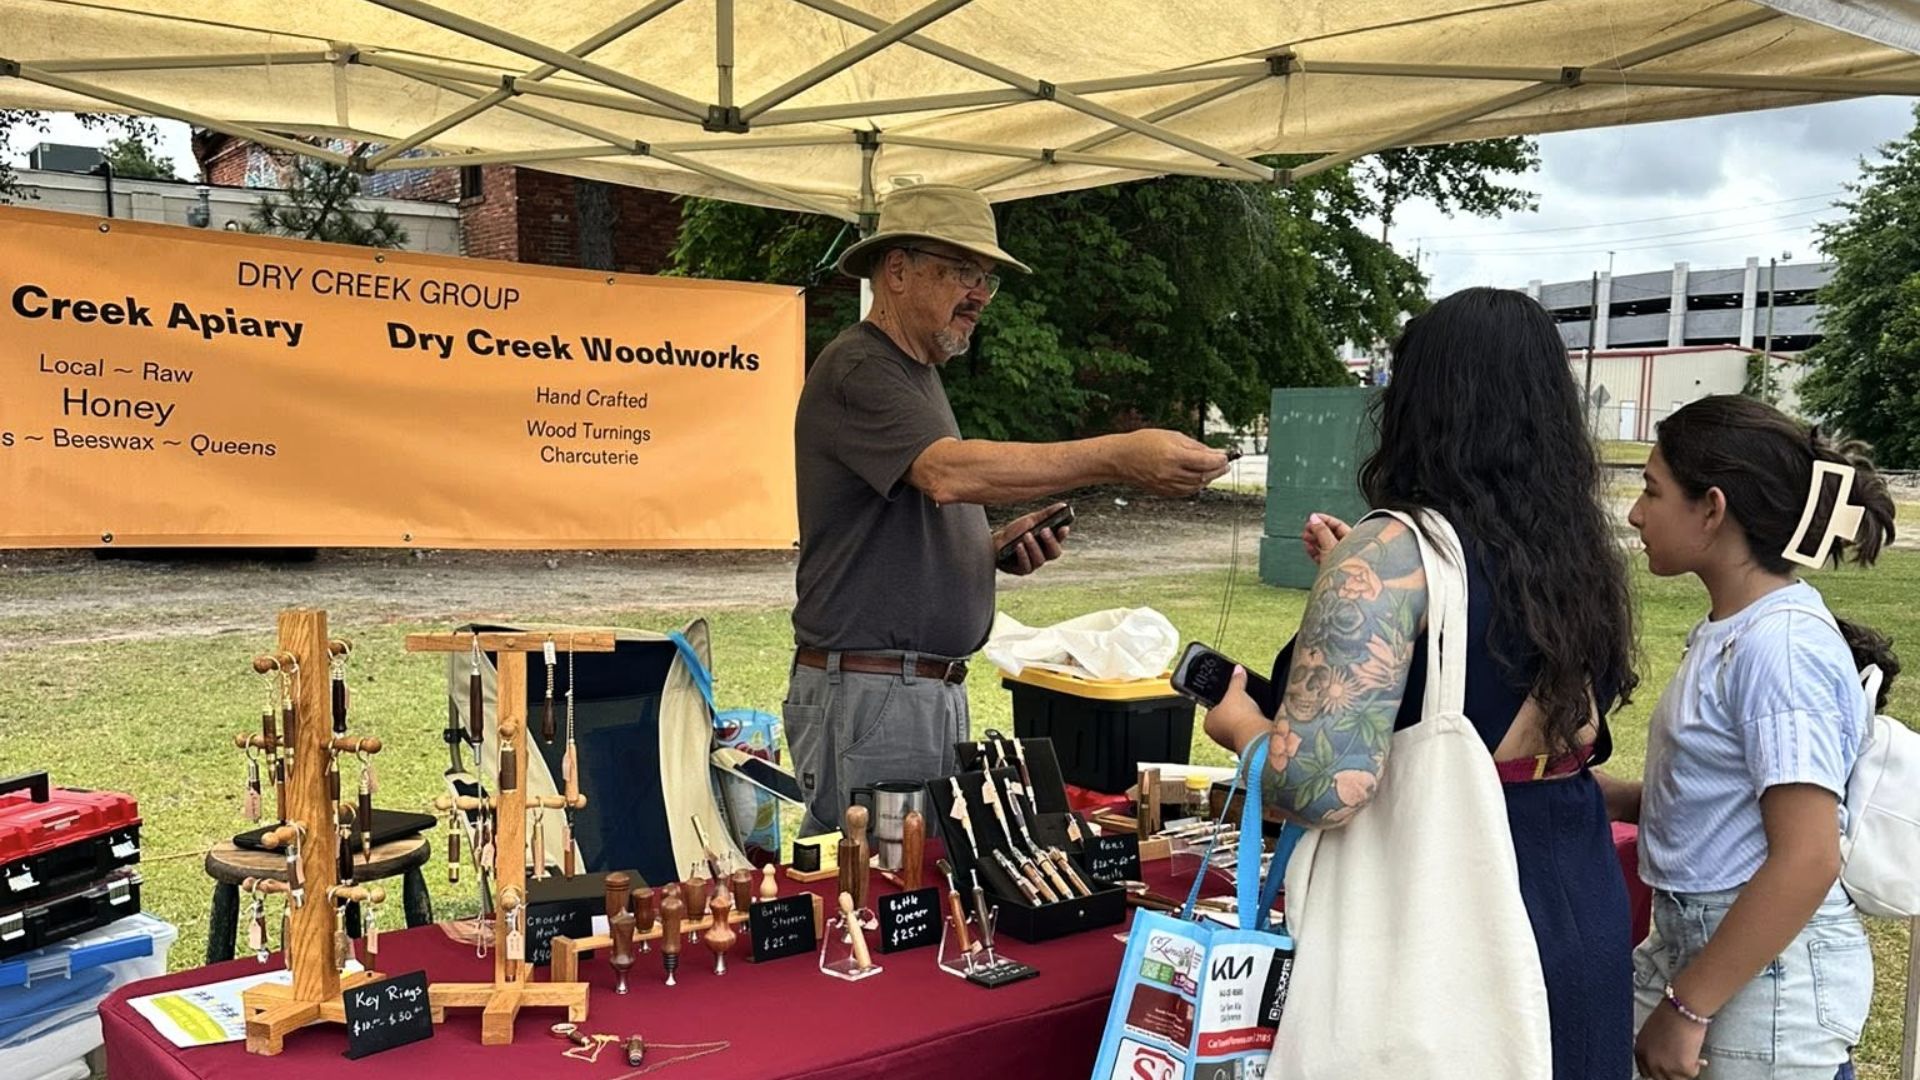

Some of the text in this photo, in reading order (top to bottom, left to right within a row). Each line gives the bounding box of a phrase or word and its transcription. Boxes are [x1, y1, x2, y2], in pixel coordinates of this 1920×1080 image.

[238, 262, 520, 310] DRY CREEK GROUP
[12, 285, 303, 346] Creek Apiary
[387, 322, 760, 371] Dry Creek Woodworks
[40, 353, 104, 377] Local
[143, 362, 194, 383] Raw
[63, 388, 176, 427] Honey
[536, 387, 648, 409] Hand Crafted
[53, 428, 155, 450] Beeswax
[191, 434, 277, 456] Queens
[527, 420, 651, 445] Wood Turnings
[540, 446, 639, 465] Charcuterie
[1192, 657, 1217, 690] 10:26
[355, 984, 423, 1011] Key Rings
